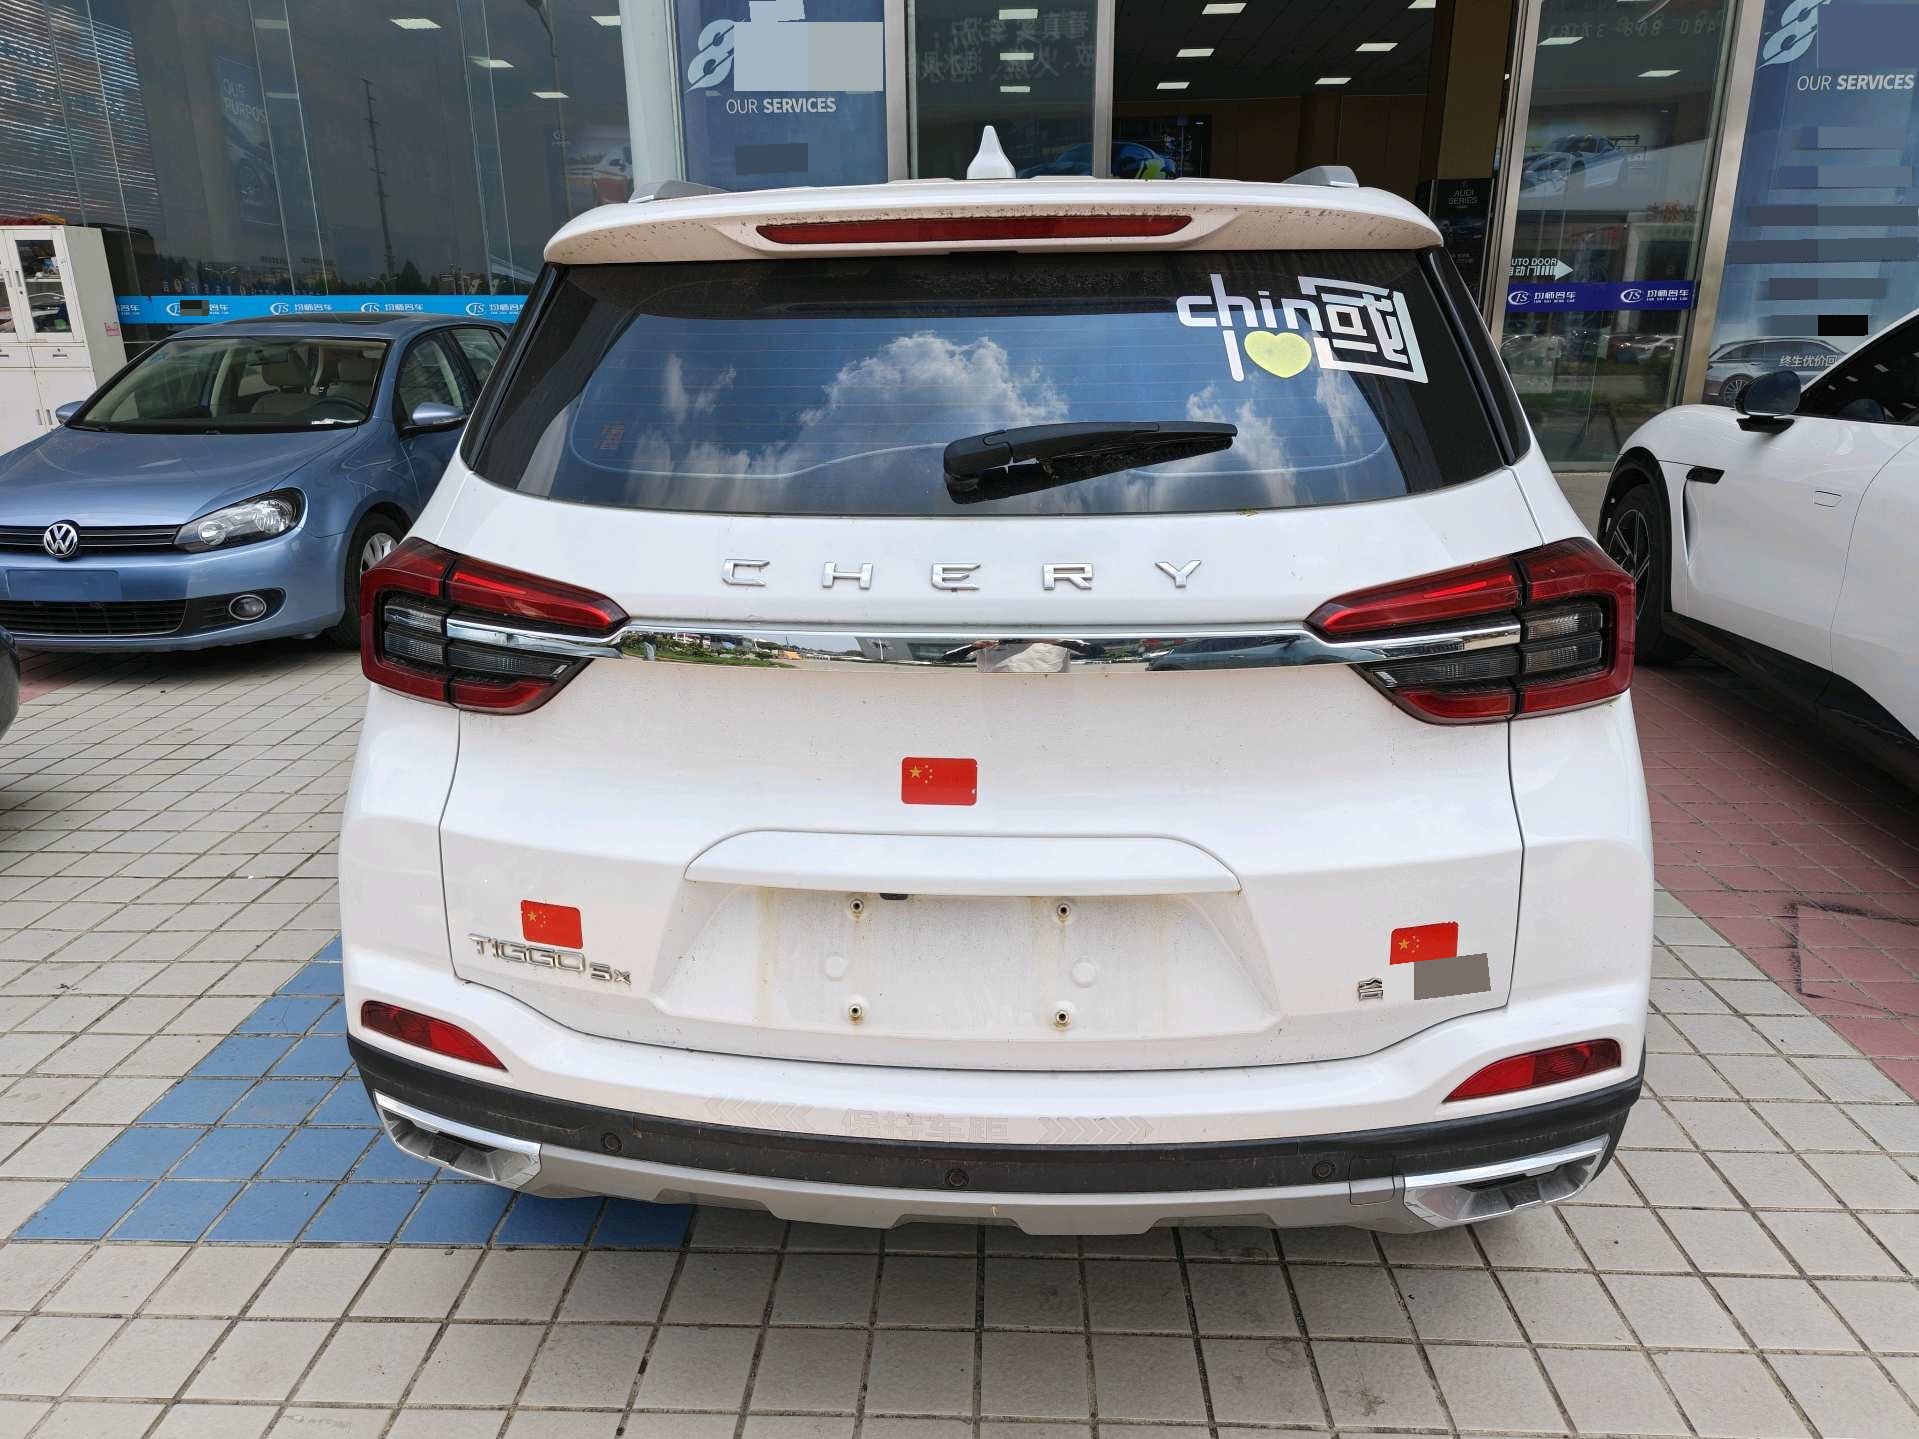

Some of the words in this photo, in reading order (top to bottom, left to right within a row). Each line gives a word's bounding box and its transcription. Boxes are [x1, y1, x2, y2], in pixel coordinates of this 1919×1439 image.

[1797, 75, 1832, 91] OUR
[1836, 74, 1915, 90] SERVICES
[726, 99, 759, 114] OUR
[763, 98, 836, 114] SERVICES
[1511, 257, 1530, 266] UTO
[1531, 257, 1557, 266] DOOR
[1779, 354, 1838, 368] 终生优价回
[721, 557, 1202, 591] CHERY
[468, 932, 586, 976] TIGGO
[841, 1108, 1009, 1144] 保持车距
